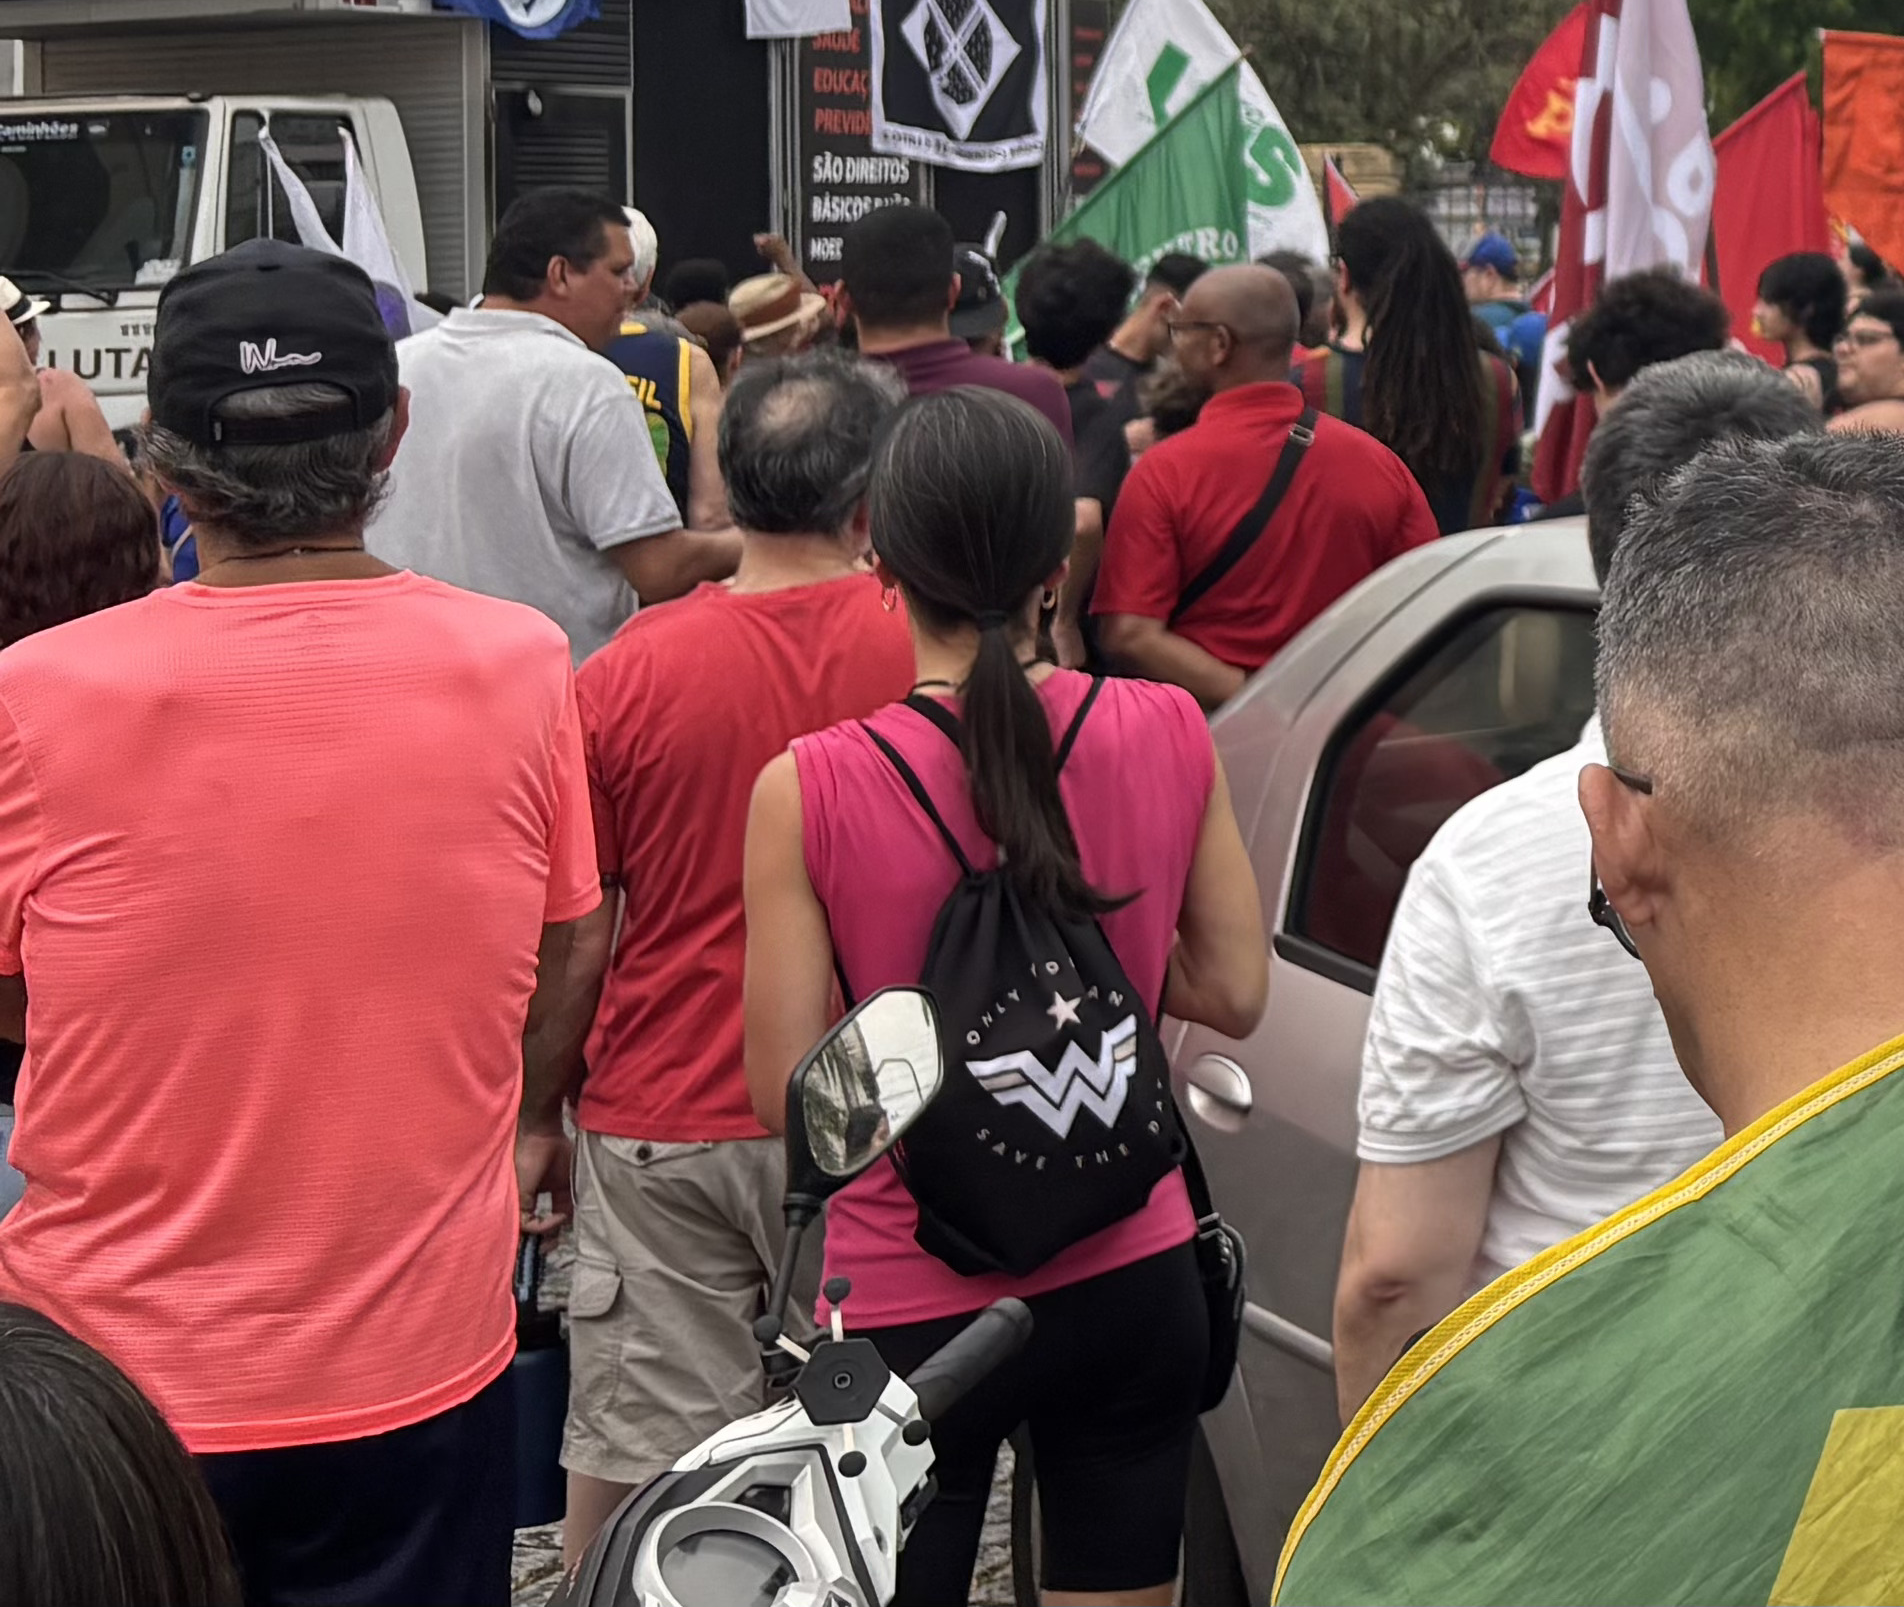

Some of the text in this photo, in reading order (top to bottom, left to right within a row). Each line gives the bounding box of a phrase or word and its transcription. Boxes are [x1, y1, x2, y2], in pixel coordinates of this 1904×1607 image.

[812, 151, 910, 184] SÃO DIREITOS
[811, 190, 872, 223] BÁSICOS
[966, 988, 1020, 1046] ONLY
